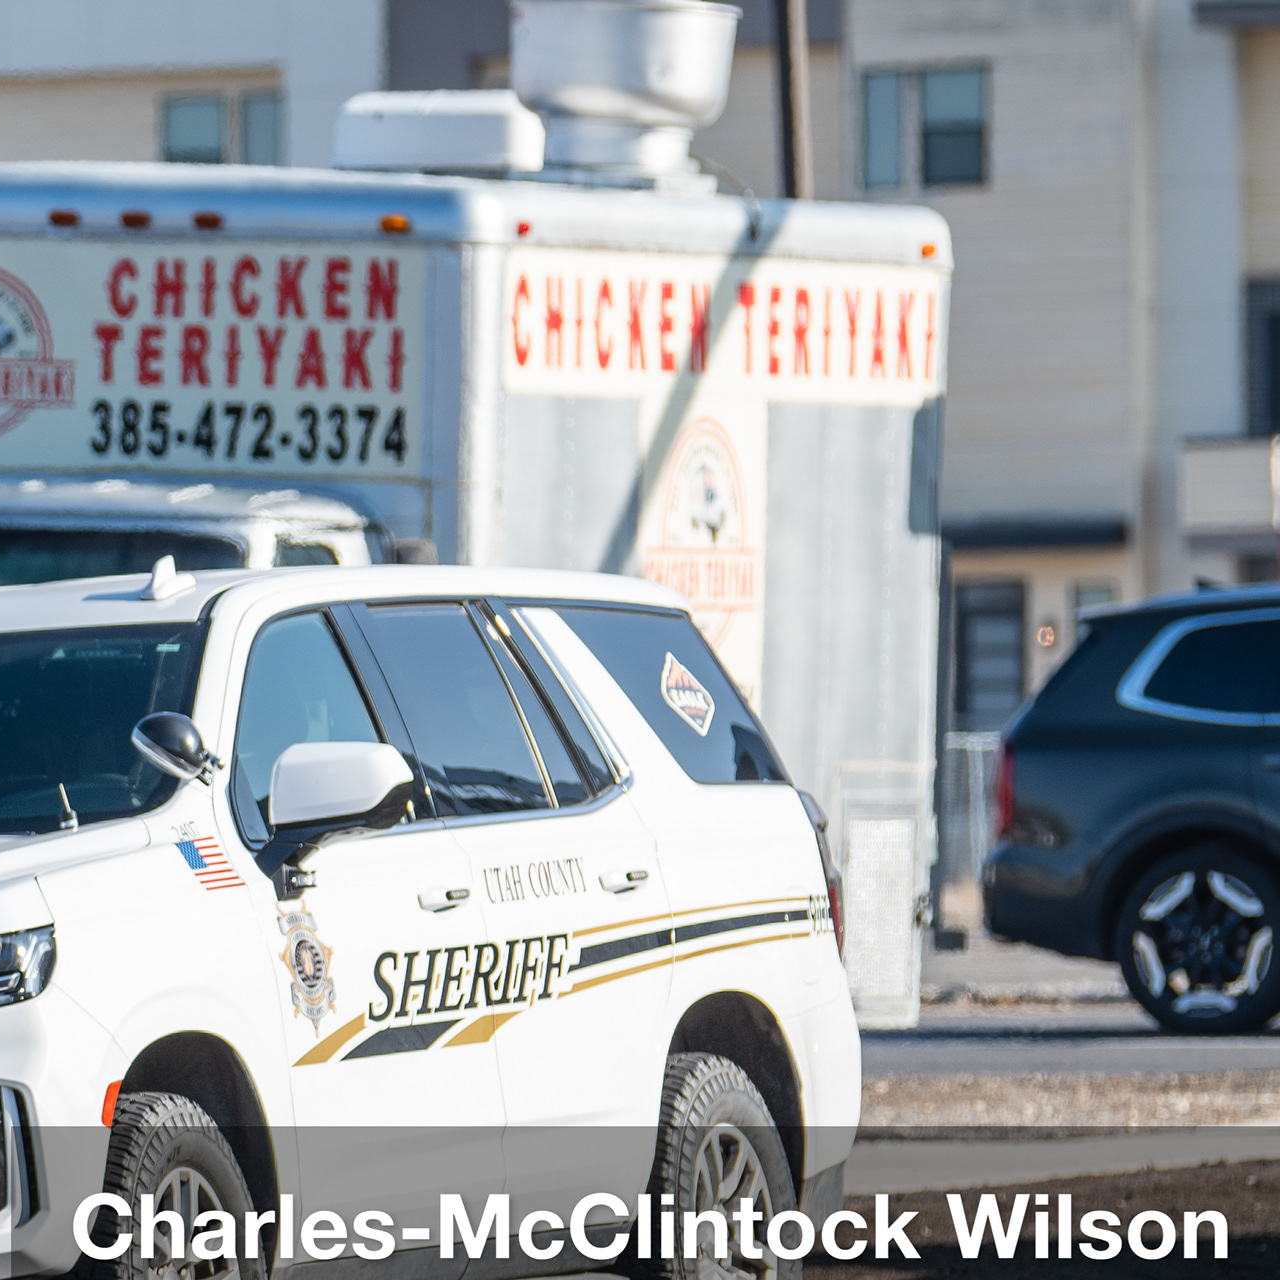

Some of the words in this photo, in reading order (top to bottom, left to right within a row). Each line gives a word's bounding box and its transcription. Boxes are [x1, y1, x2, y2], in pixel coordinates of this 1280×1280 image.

[106, 255, 400, 321] CHICKEN
[94, 322, 405, 393] TERIYAKI
[512, 274, 710, 375] CHICKEN
[738, 282, 936, 379] TERIYAKI
[483, 864, 525, 904] UTAH
[528, 857, 587, 898] COUNTY
[368, 933, 568, 1022] SHERIFF
